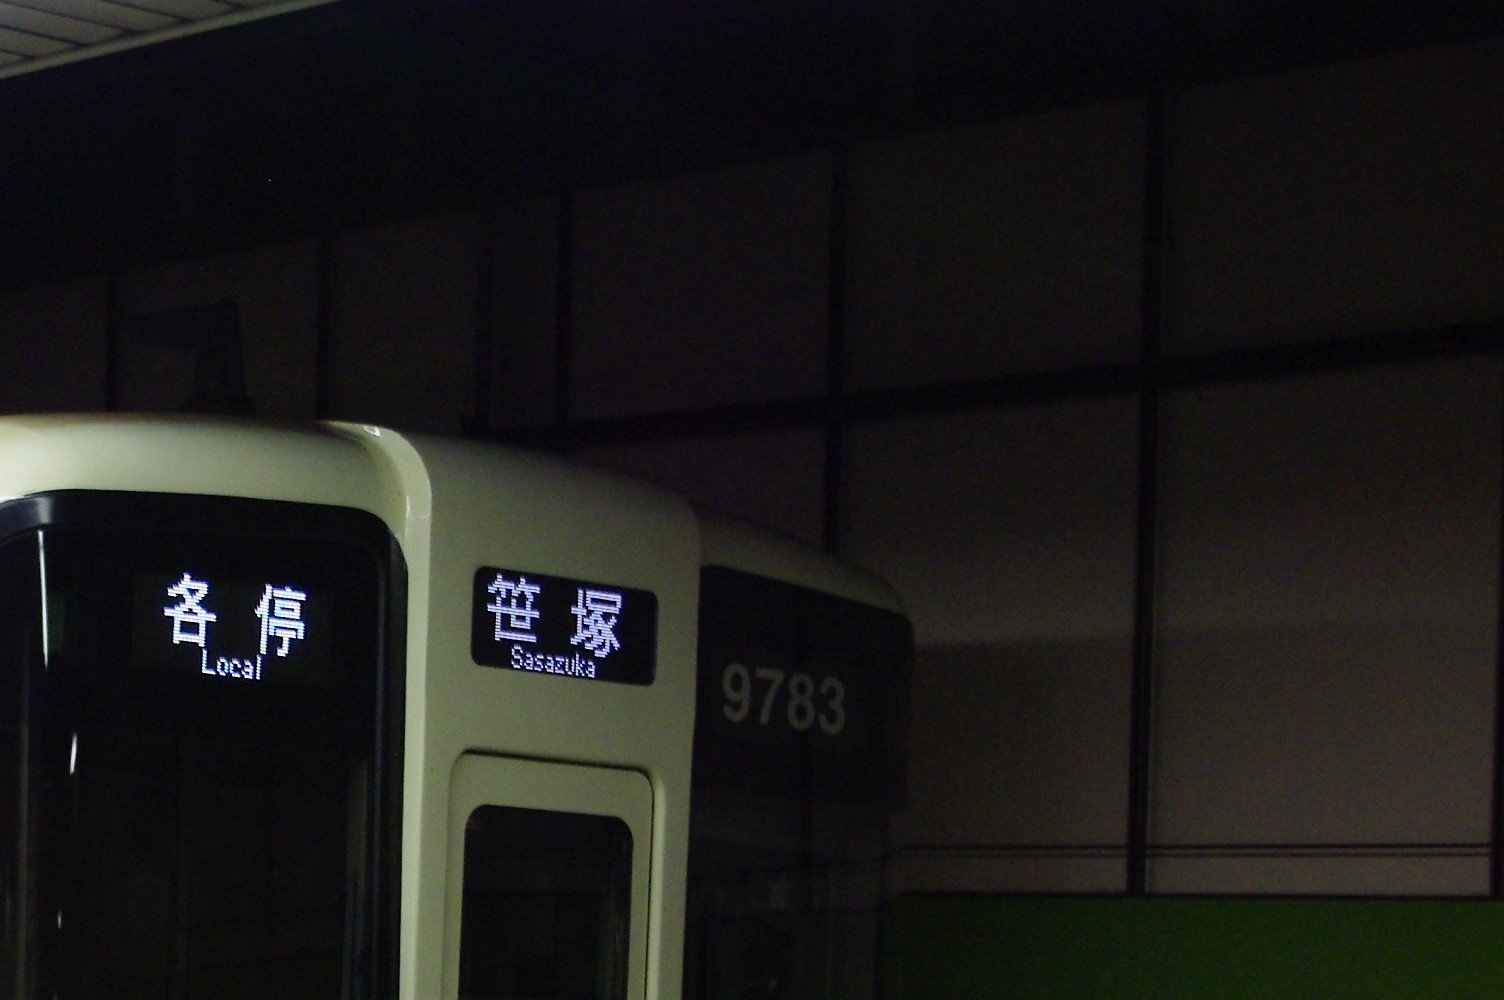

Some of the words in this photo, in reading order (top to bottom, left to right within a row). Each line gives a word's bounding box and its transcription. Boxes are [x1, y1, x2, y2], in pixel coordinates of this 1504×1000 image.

[163, 572, 307, 657] 各停
[487, 573, 622, 658] 笹塚
[201, 648, 262, 680] Local
[510, 644, 596, 678] Sasazuka
[722, 662, 846, 735] 9783
